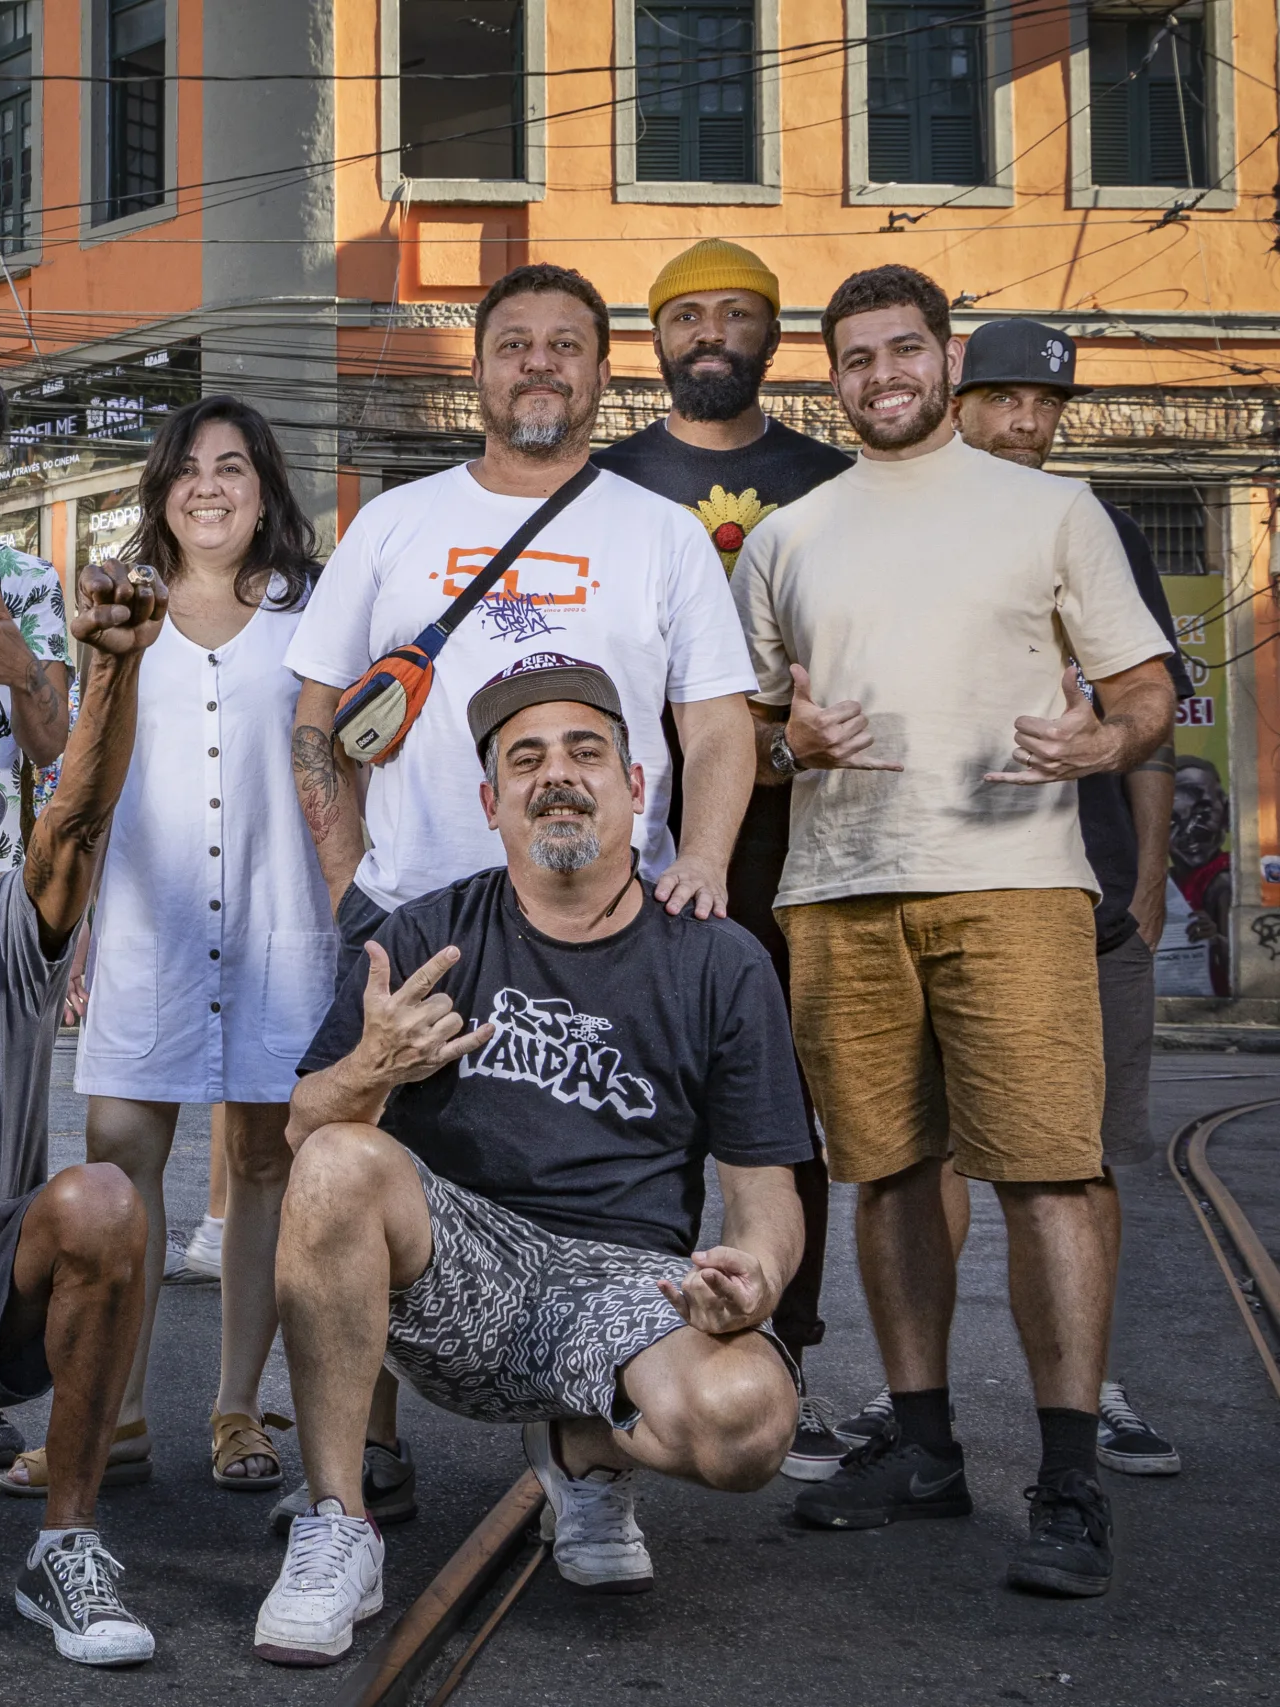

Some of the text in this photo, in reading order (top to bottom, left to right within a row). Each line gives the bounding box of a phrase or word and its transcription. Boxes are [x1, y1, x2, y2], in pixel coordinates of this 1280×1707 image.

[12, 462, 40, 477] ATRAVÉS
[43, 460, 54, 470] DO
[54, 454, 80, 467] CINEMA
[522, 654, 556, 668] RIEN
